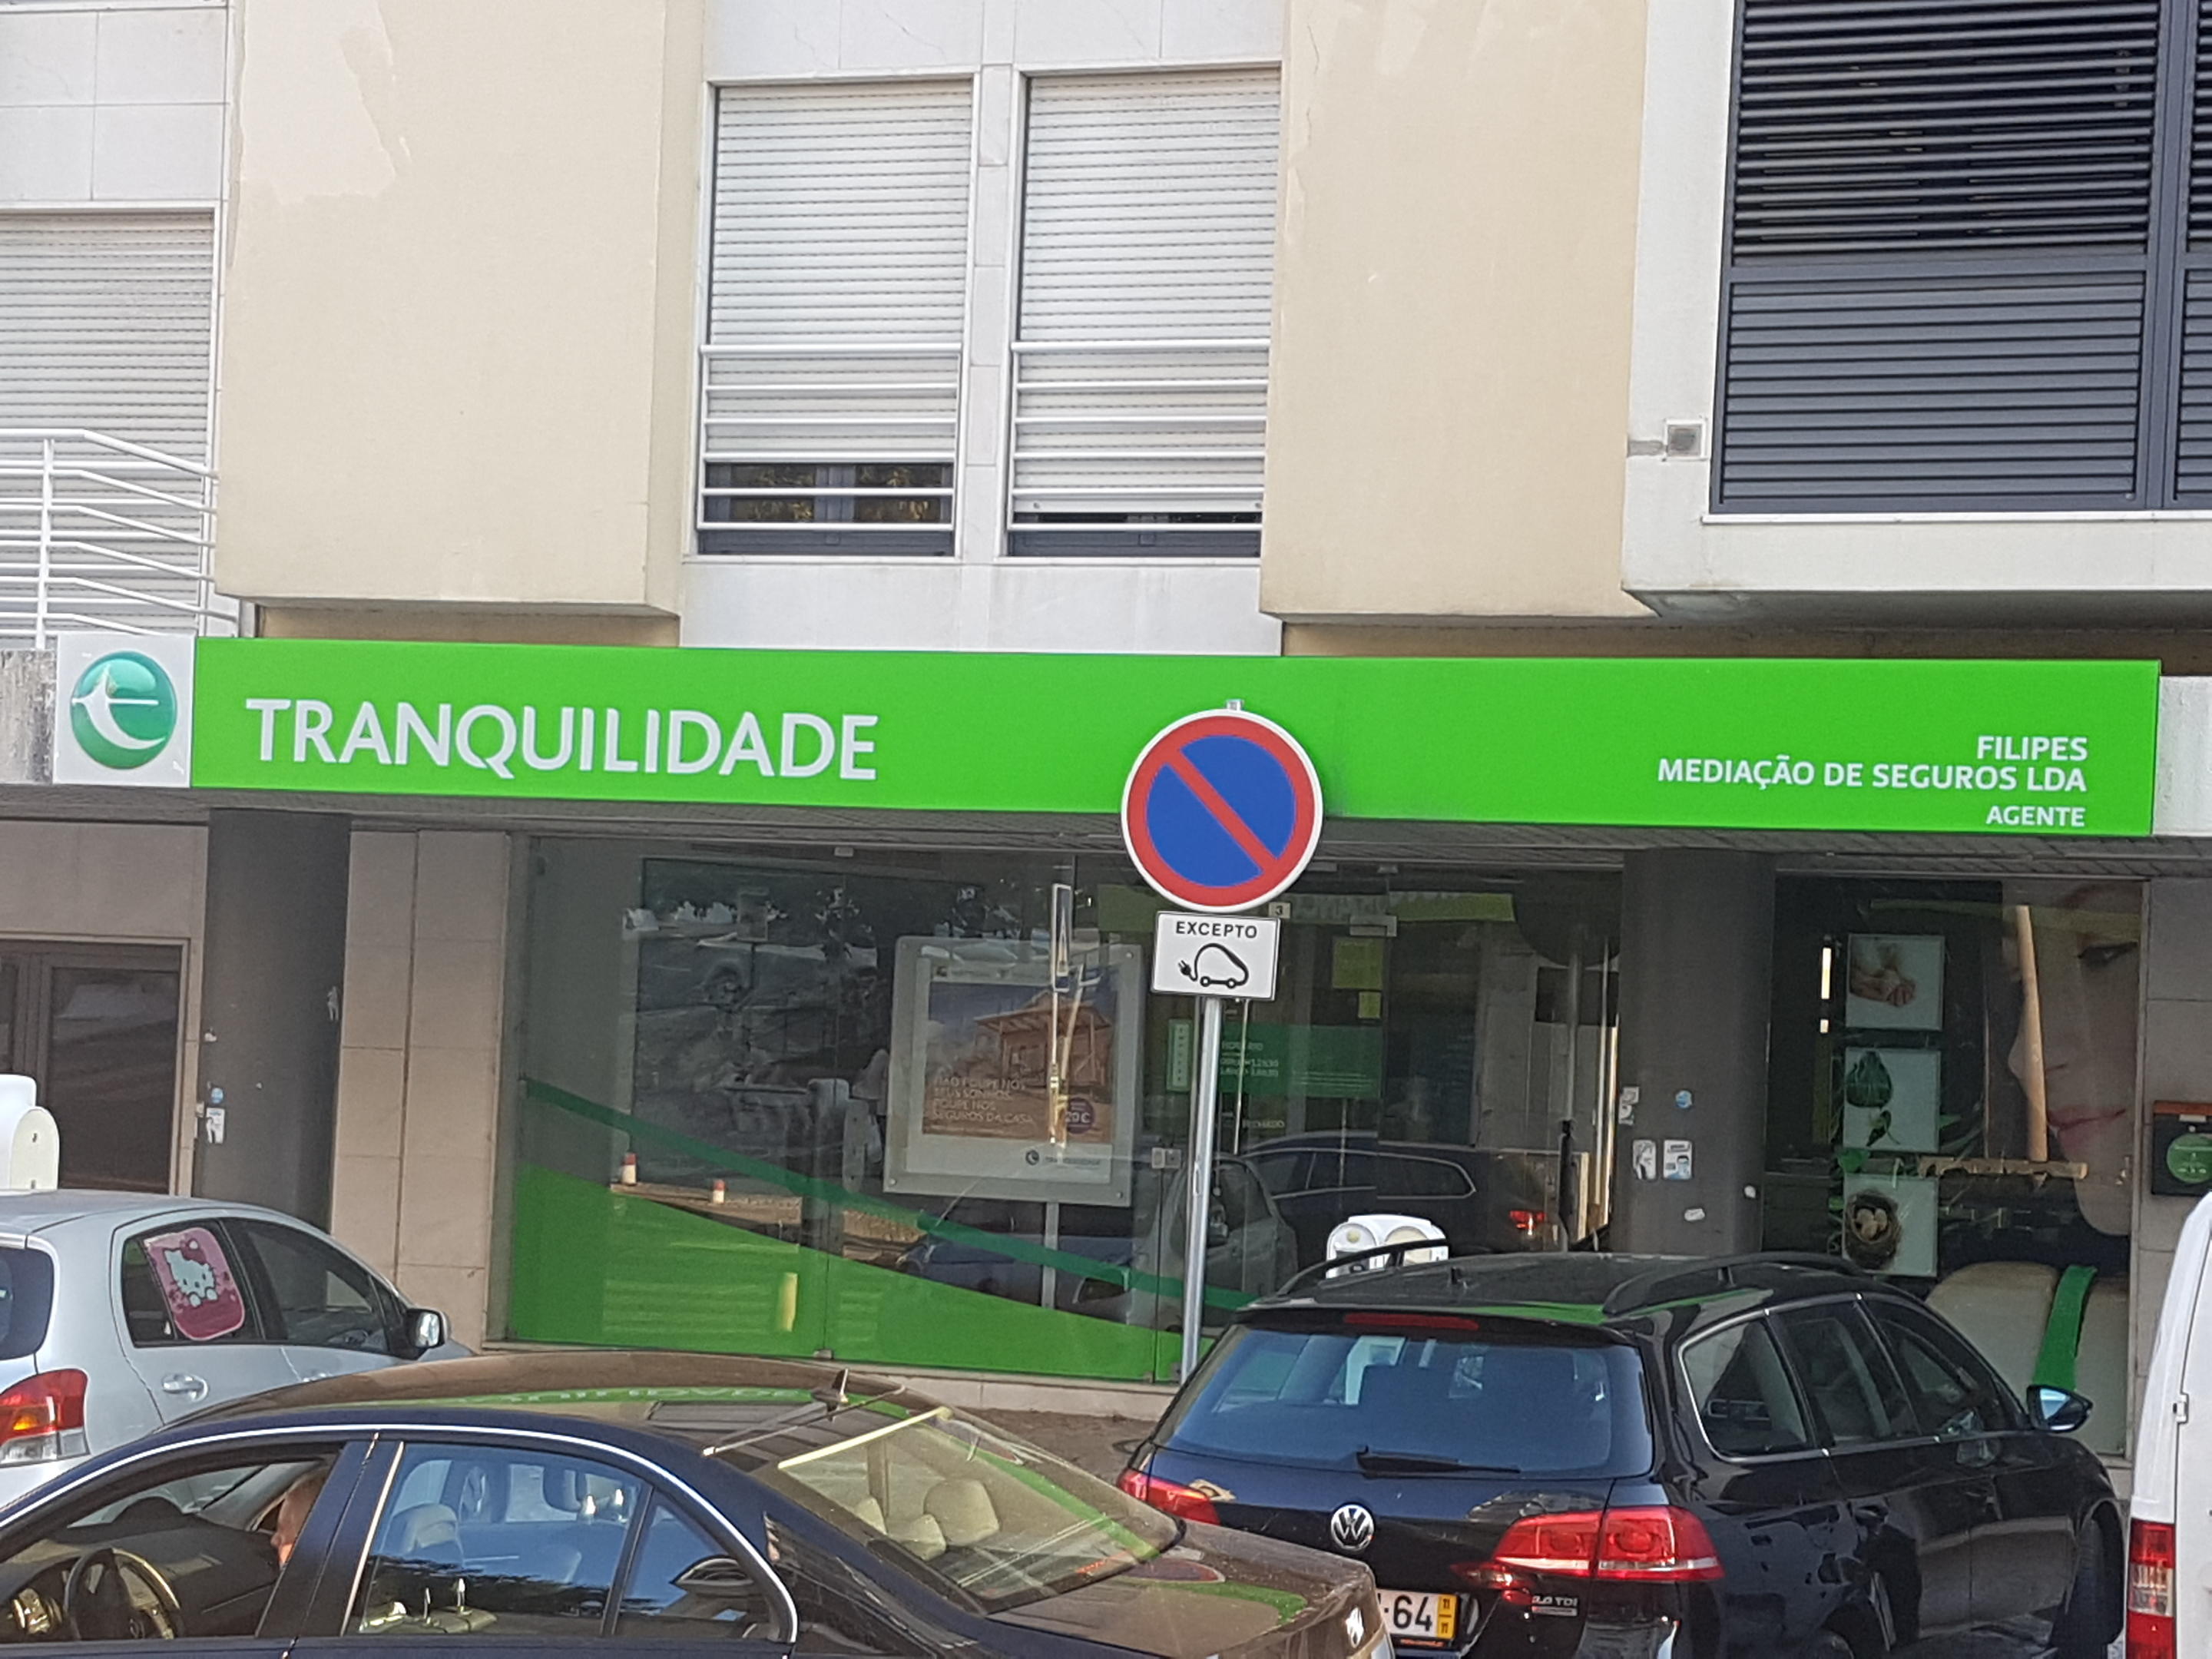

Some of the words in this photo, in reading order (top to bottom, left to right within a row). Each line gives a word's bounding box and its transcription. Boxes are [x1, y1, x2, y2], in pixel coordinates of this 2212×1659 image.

[245, 698, 878, 780] TRANQUILIDADE
[1976, 735, 2088, 761] FILIPES
[1657, 754, 1815, 790] MEDIAÇÃO
[1823, 763, 1863, 787] DE
[1872, 763, 2017, 792] SEGUROS
[2025, 766, 2088, 793] LDA
[1985, 806, 2086, 827] AGENTE
[1175, 921, 1258, 939] EXCEPTO
